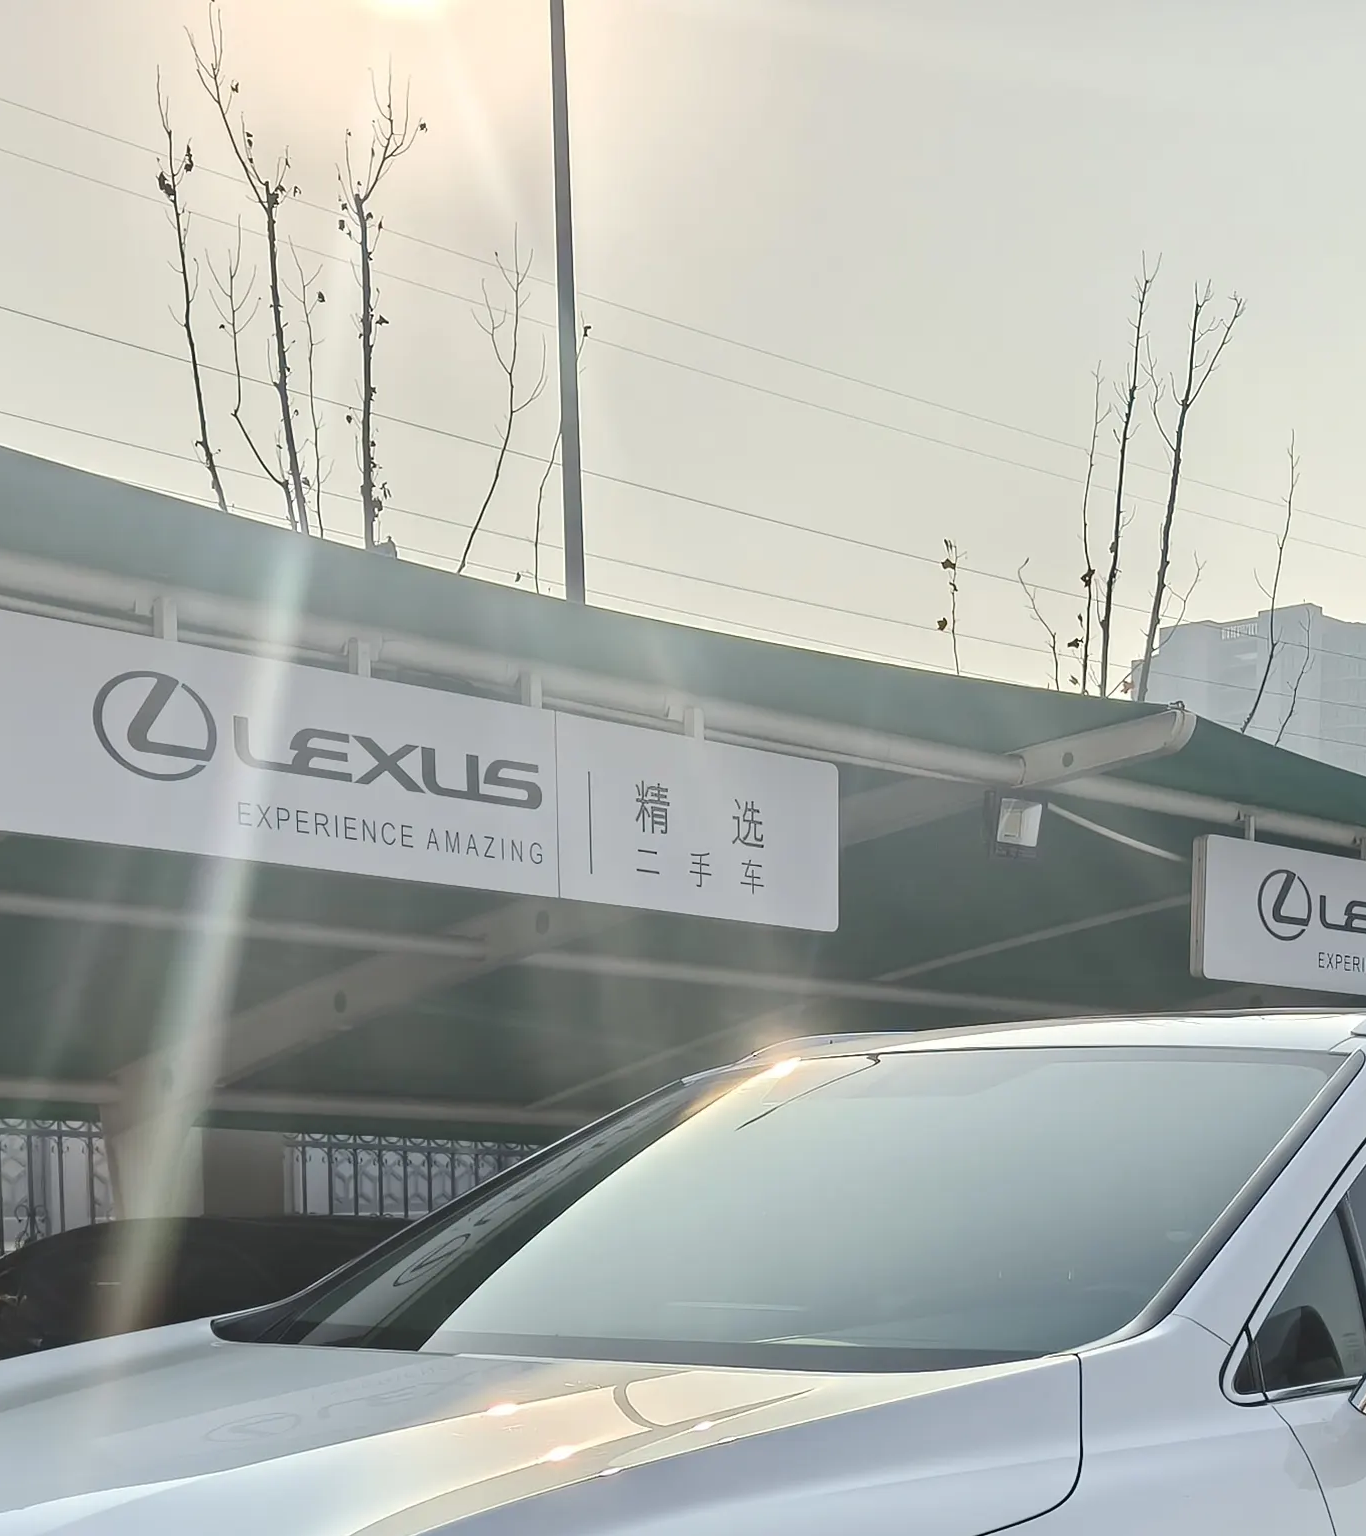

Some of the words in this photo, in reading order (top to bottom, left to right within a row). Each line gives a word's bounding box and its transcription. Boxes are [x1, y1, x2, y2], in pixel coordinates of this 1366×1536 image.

[234, 715, 542, 810] LEXUS
[237, 802, 415, 850] EXPERIENCE
[426, 828, 544, 865] AMAZING
[634, 780, 766, 850] 精选
[636, 848, 766, 895] 二手车
